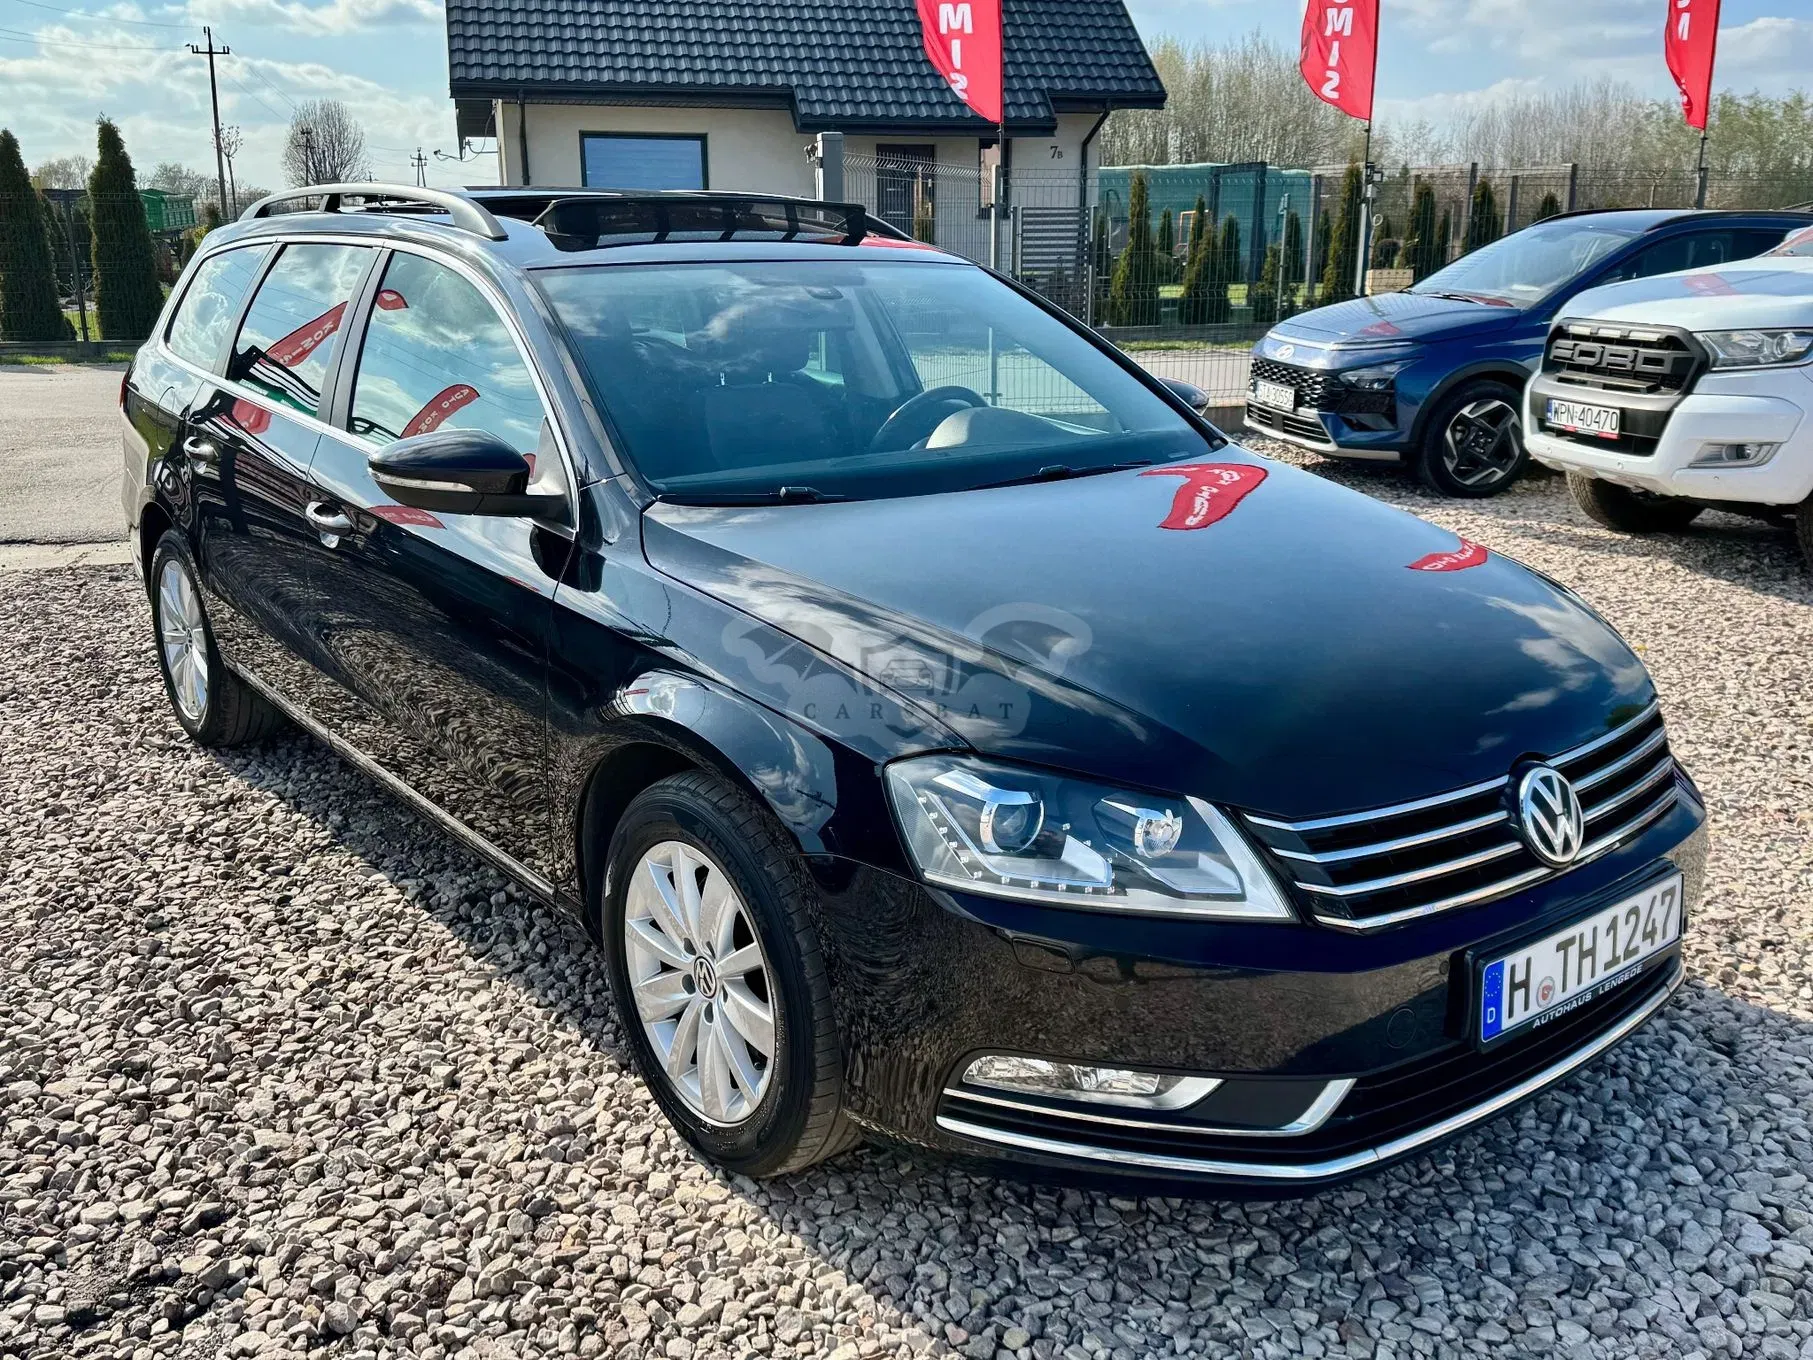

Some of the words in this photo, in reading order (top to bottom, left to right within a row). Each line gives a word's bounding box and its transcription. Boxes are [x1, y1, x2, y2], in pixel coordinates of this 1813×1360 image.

[1578, 407, 1619, 431] 40470
[1508, 956, 1532, 1020] H
[1532, 992, 1592, 1029] AUTOHAUS
[1598, 964, 1643, 994] LENGEDE
[1486, 1007, 1496, 1024] D
